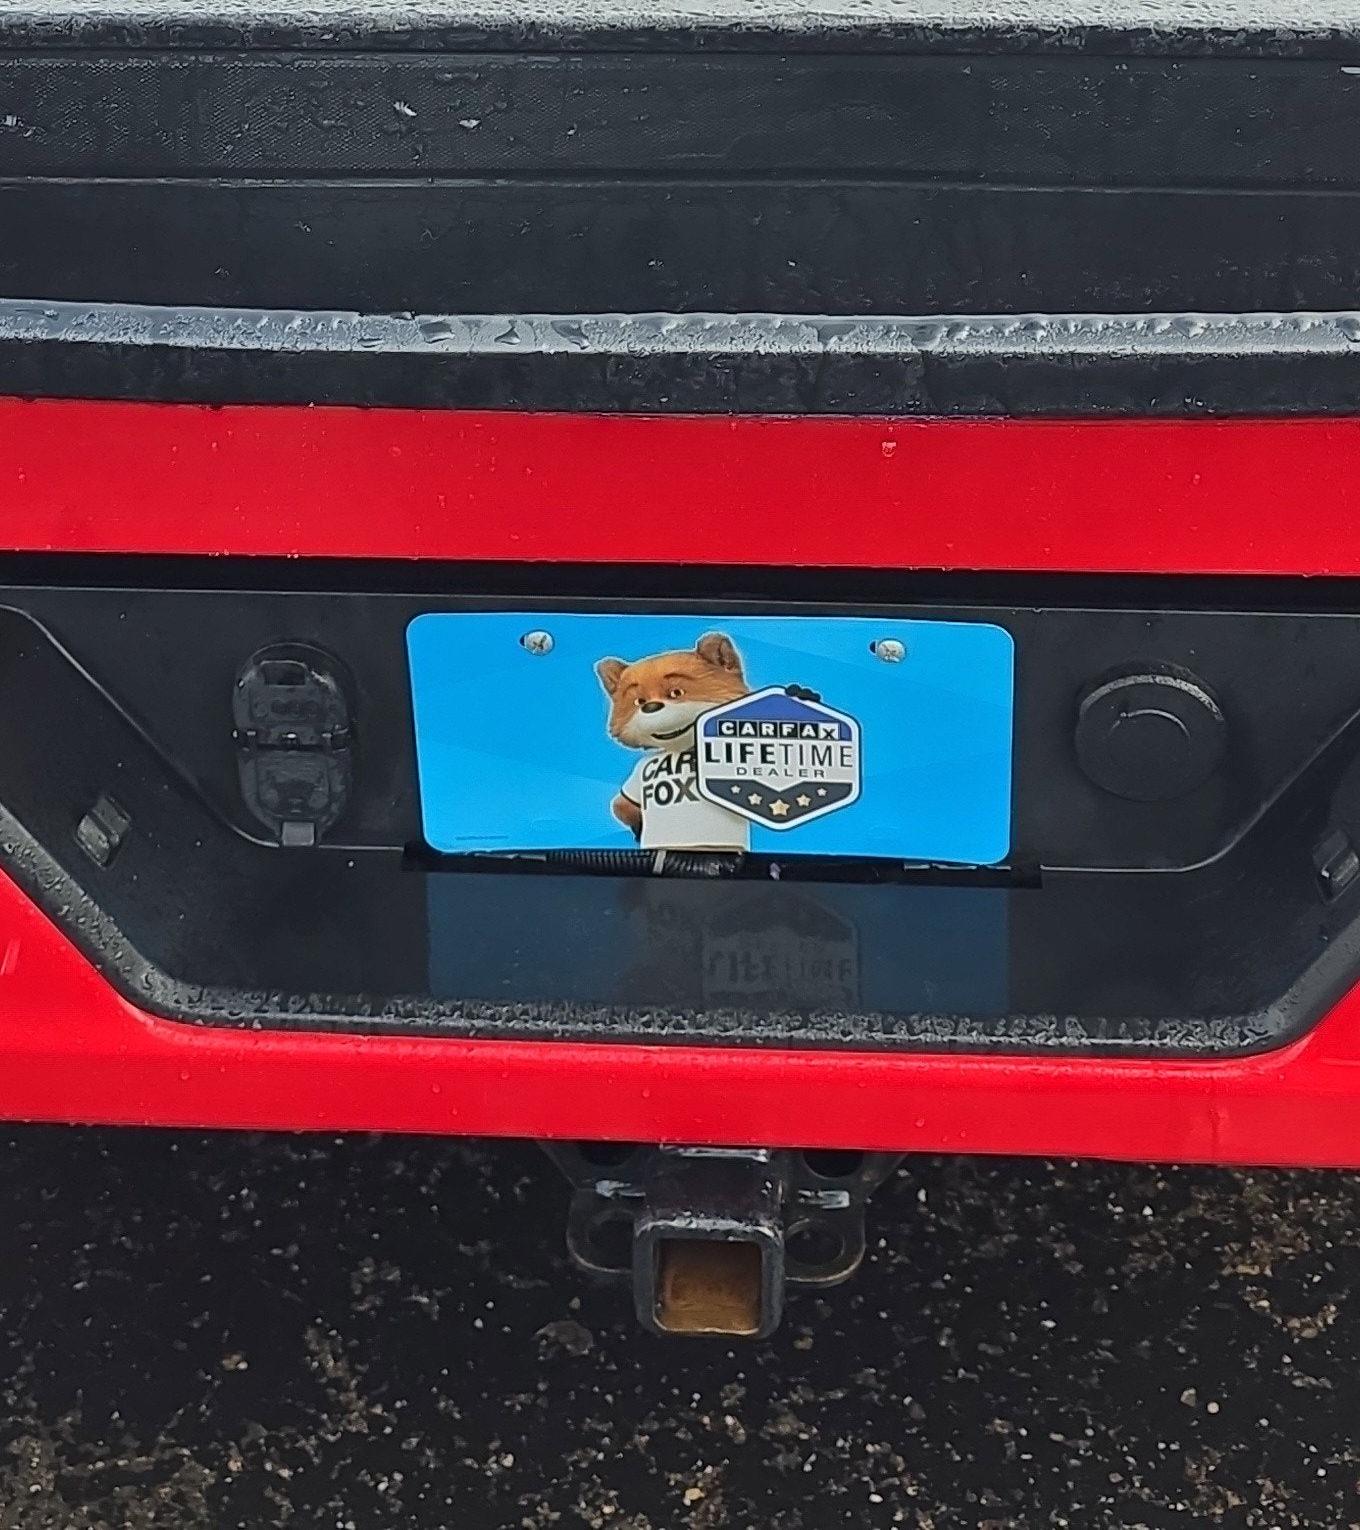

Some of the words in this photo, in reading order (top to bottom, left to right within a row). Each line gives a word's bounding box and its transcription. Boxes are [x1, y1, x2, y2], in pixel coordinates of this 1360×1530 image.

[719, 721, 839, 740] CARFAX
[642, 751, 697, 782] CAR
[705, 742, 854, 768] LIFETIME
[736, 766, 826, 778] DEALER
[643, 777, 701, 811] FOX
